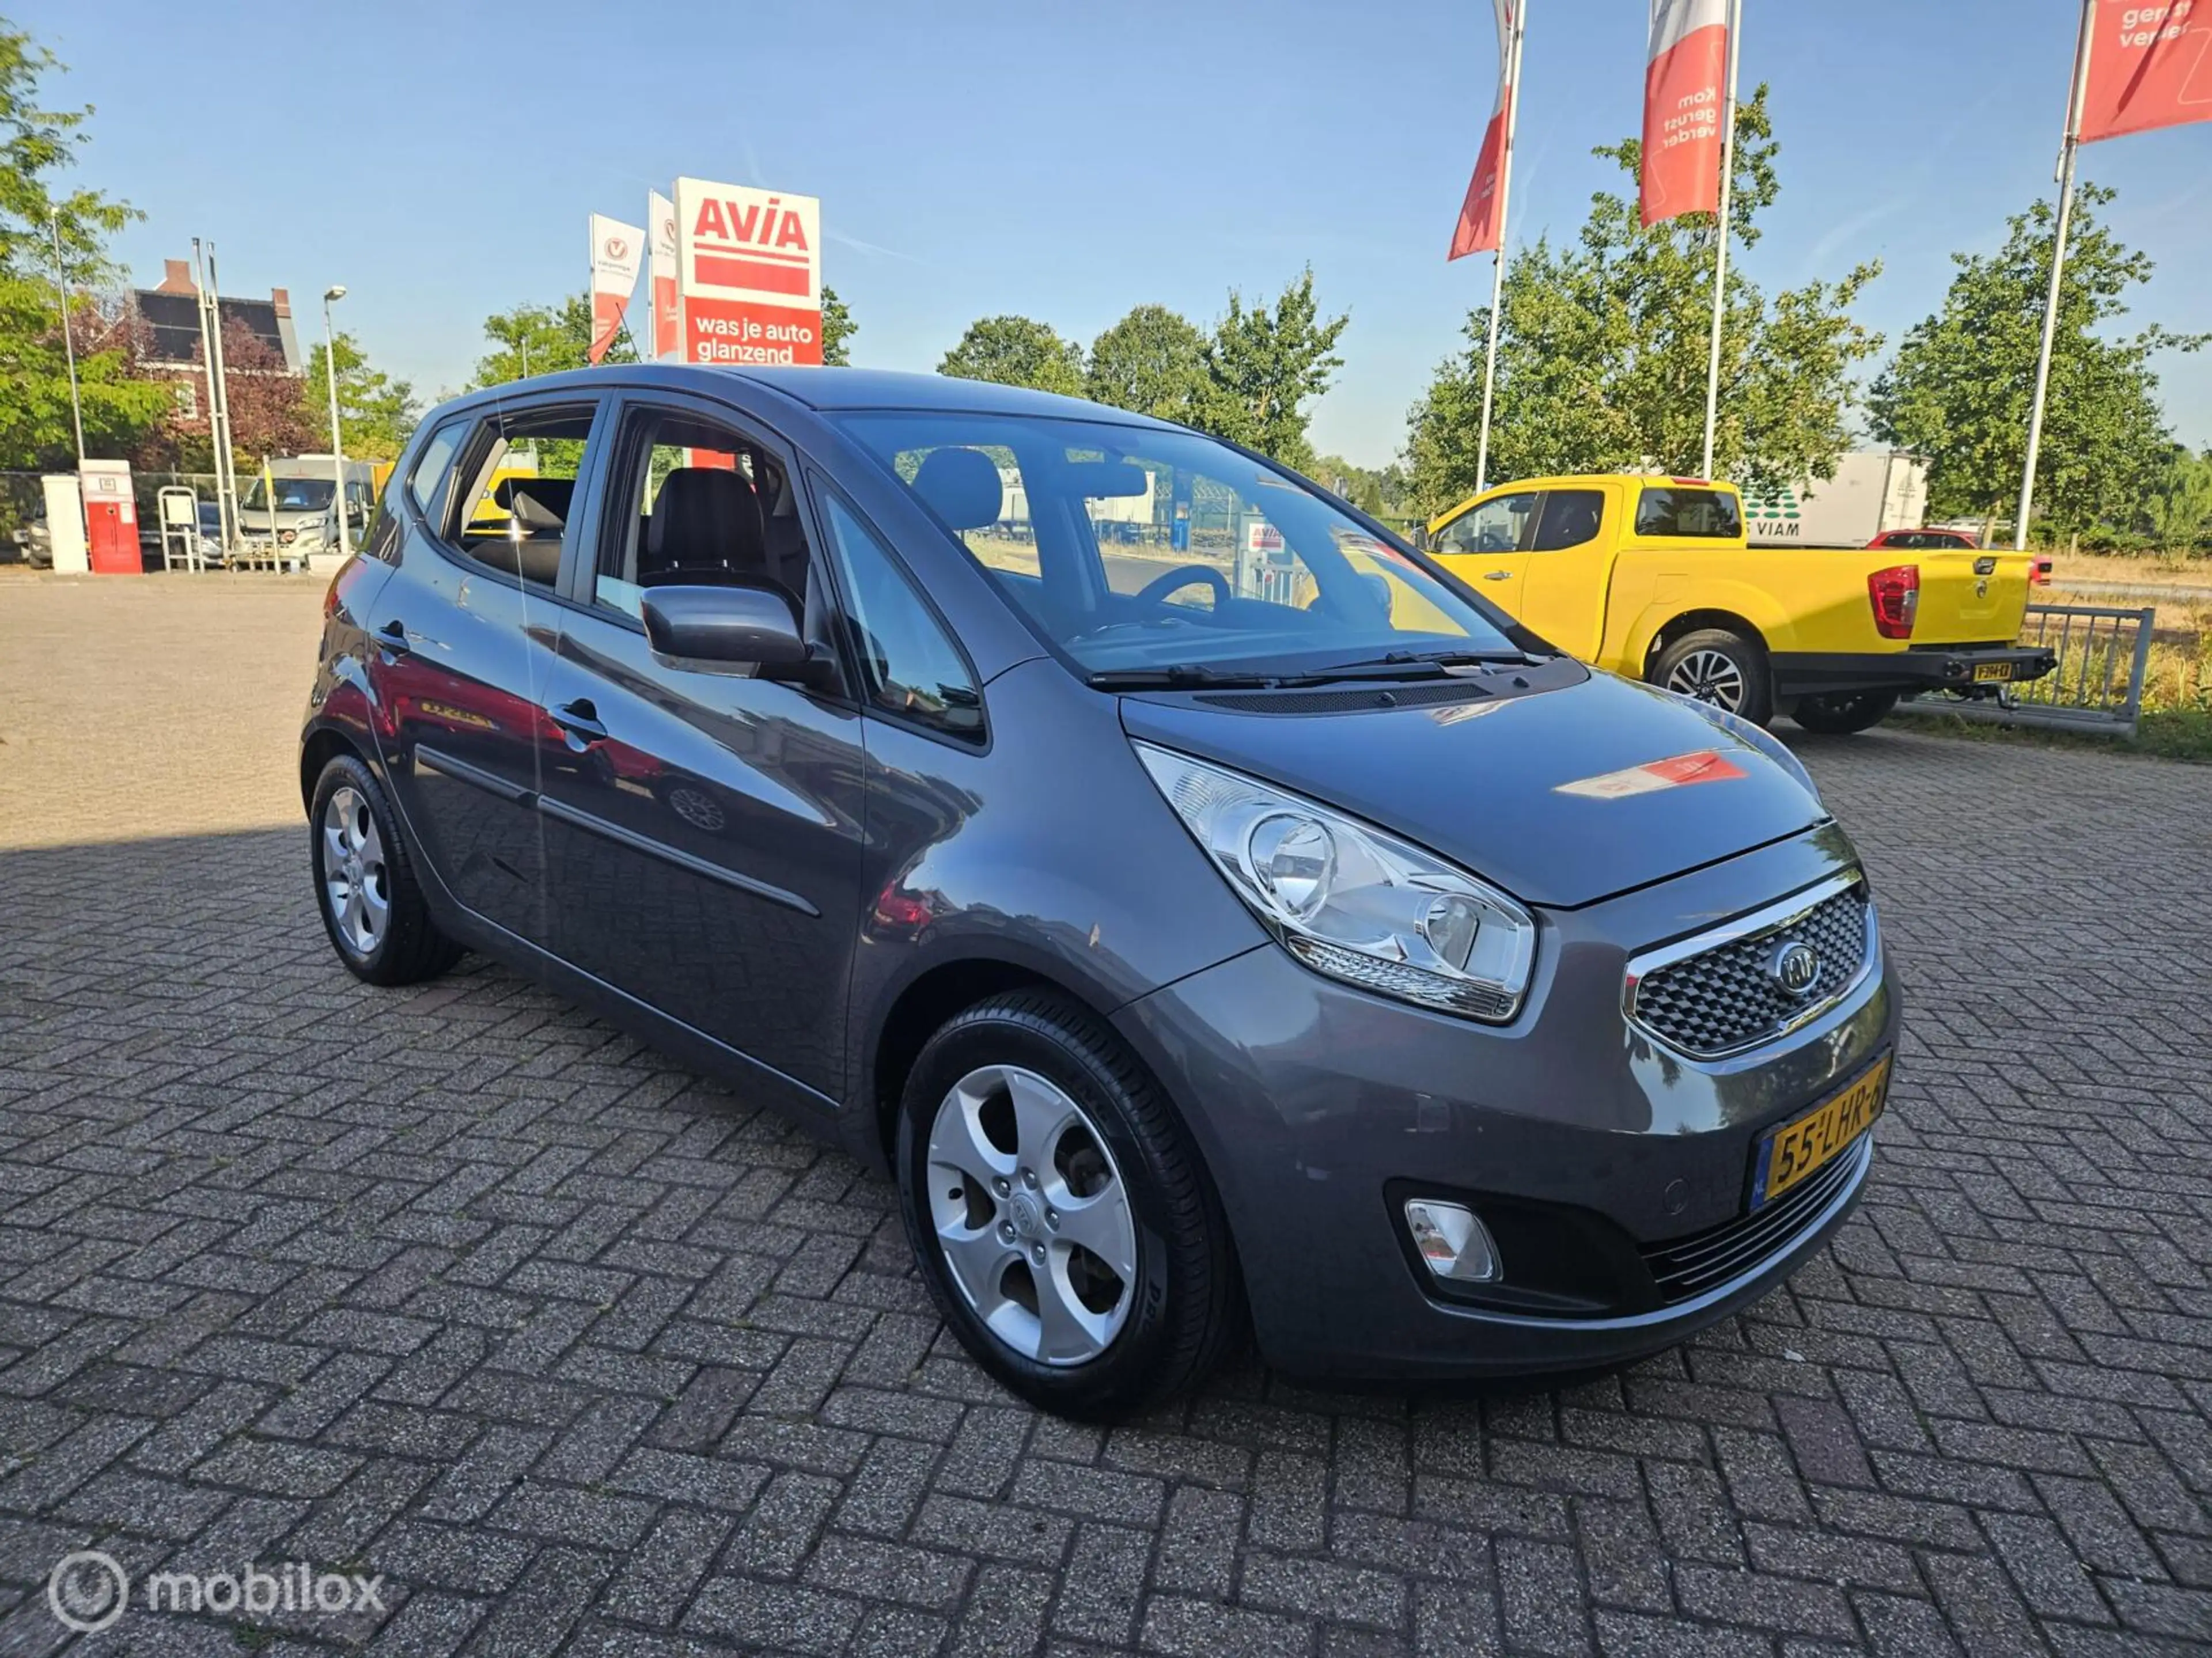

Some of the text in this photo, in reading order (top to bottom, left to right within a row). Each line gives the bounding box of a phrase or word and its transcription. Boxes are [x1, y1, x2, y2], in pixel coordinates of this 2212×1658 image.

[696, 317, 813, 343] was je auto
[697, 337, 793, 364] glanzend
[1757, 522, 1799, 536] VIAM
